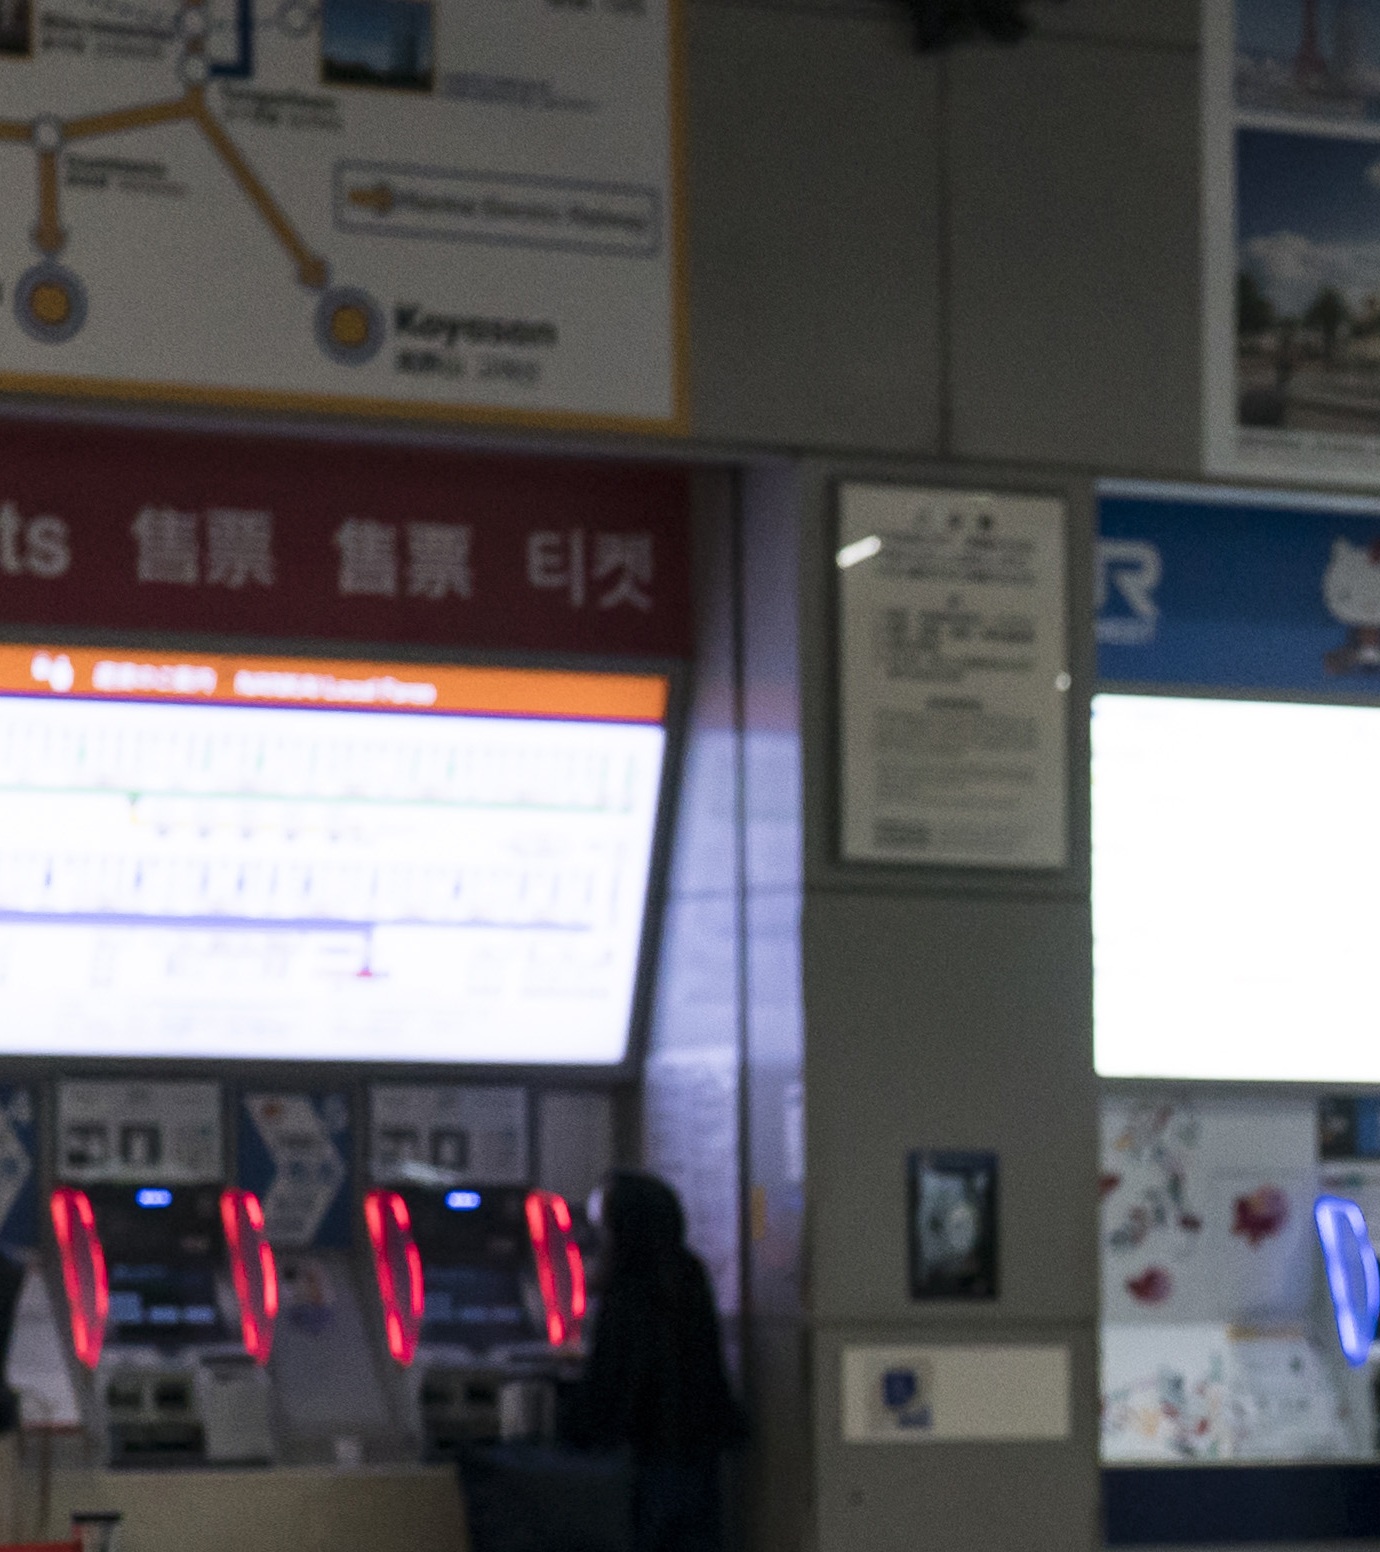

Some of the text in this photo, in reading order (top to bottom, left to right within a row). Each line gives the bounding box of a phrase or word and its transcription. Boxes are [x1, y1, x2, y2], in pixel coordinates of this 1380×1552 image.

[394, 302, 559, 350] Koyasan
[130, 502, 276, 589] 售票
[332, 514, 475, 600] 售票
[525, 525, 656, 612] 티켓
